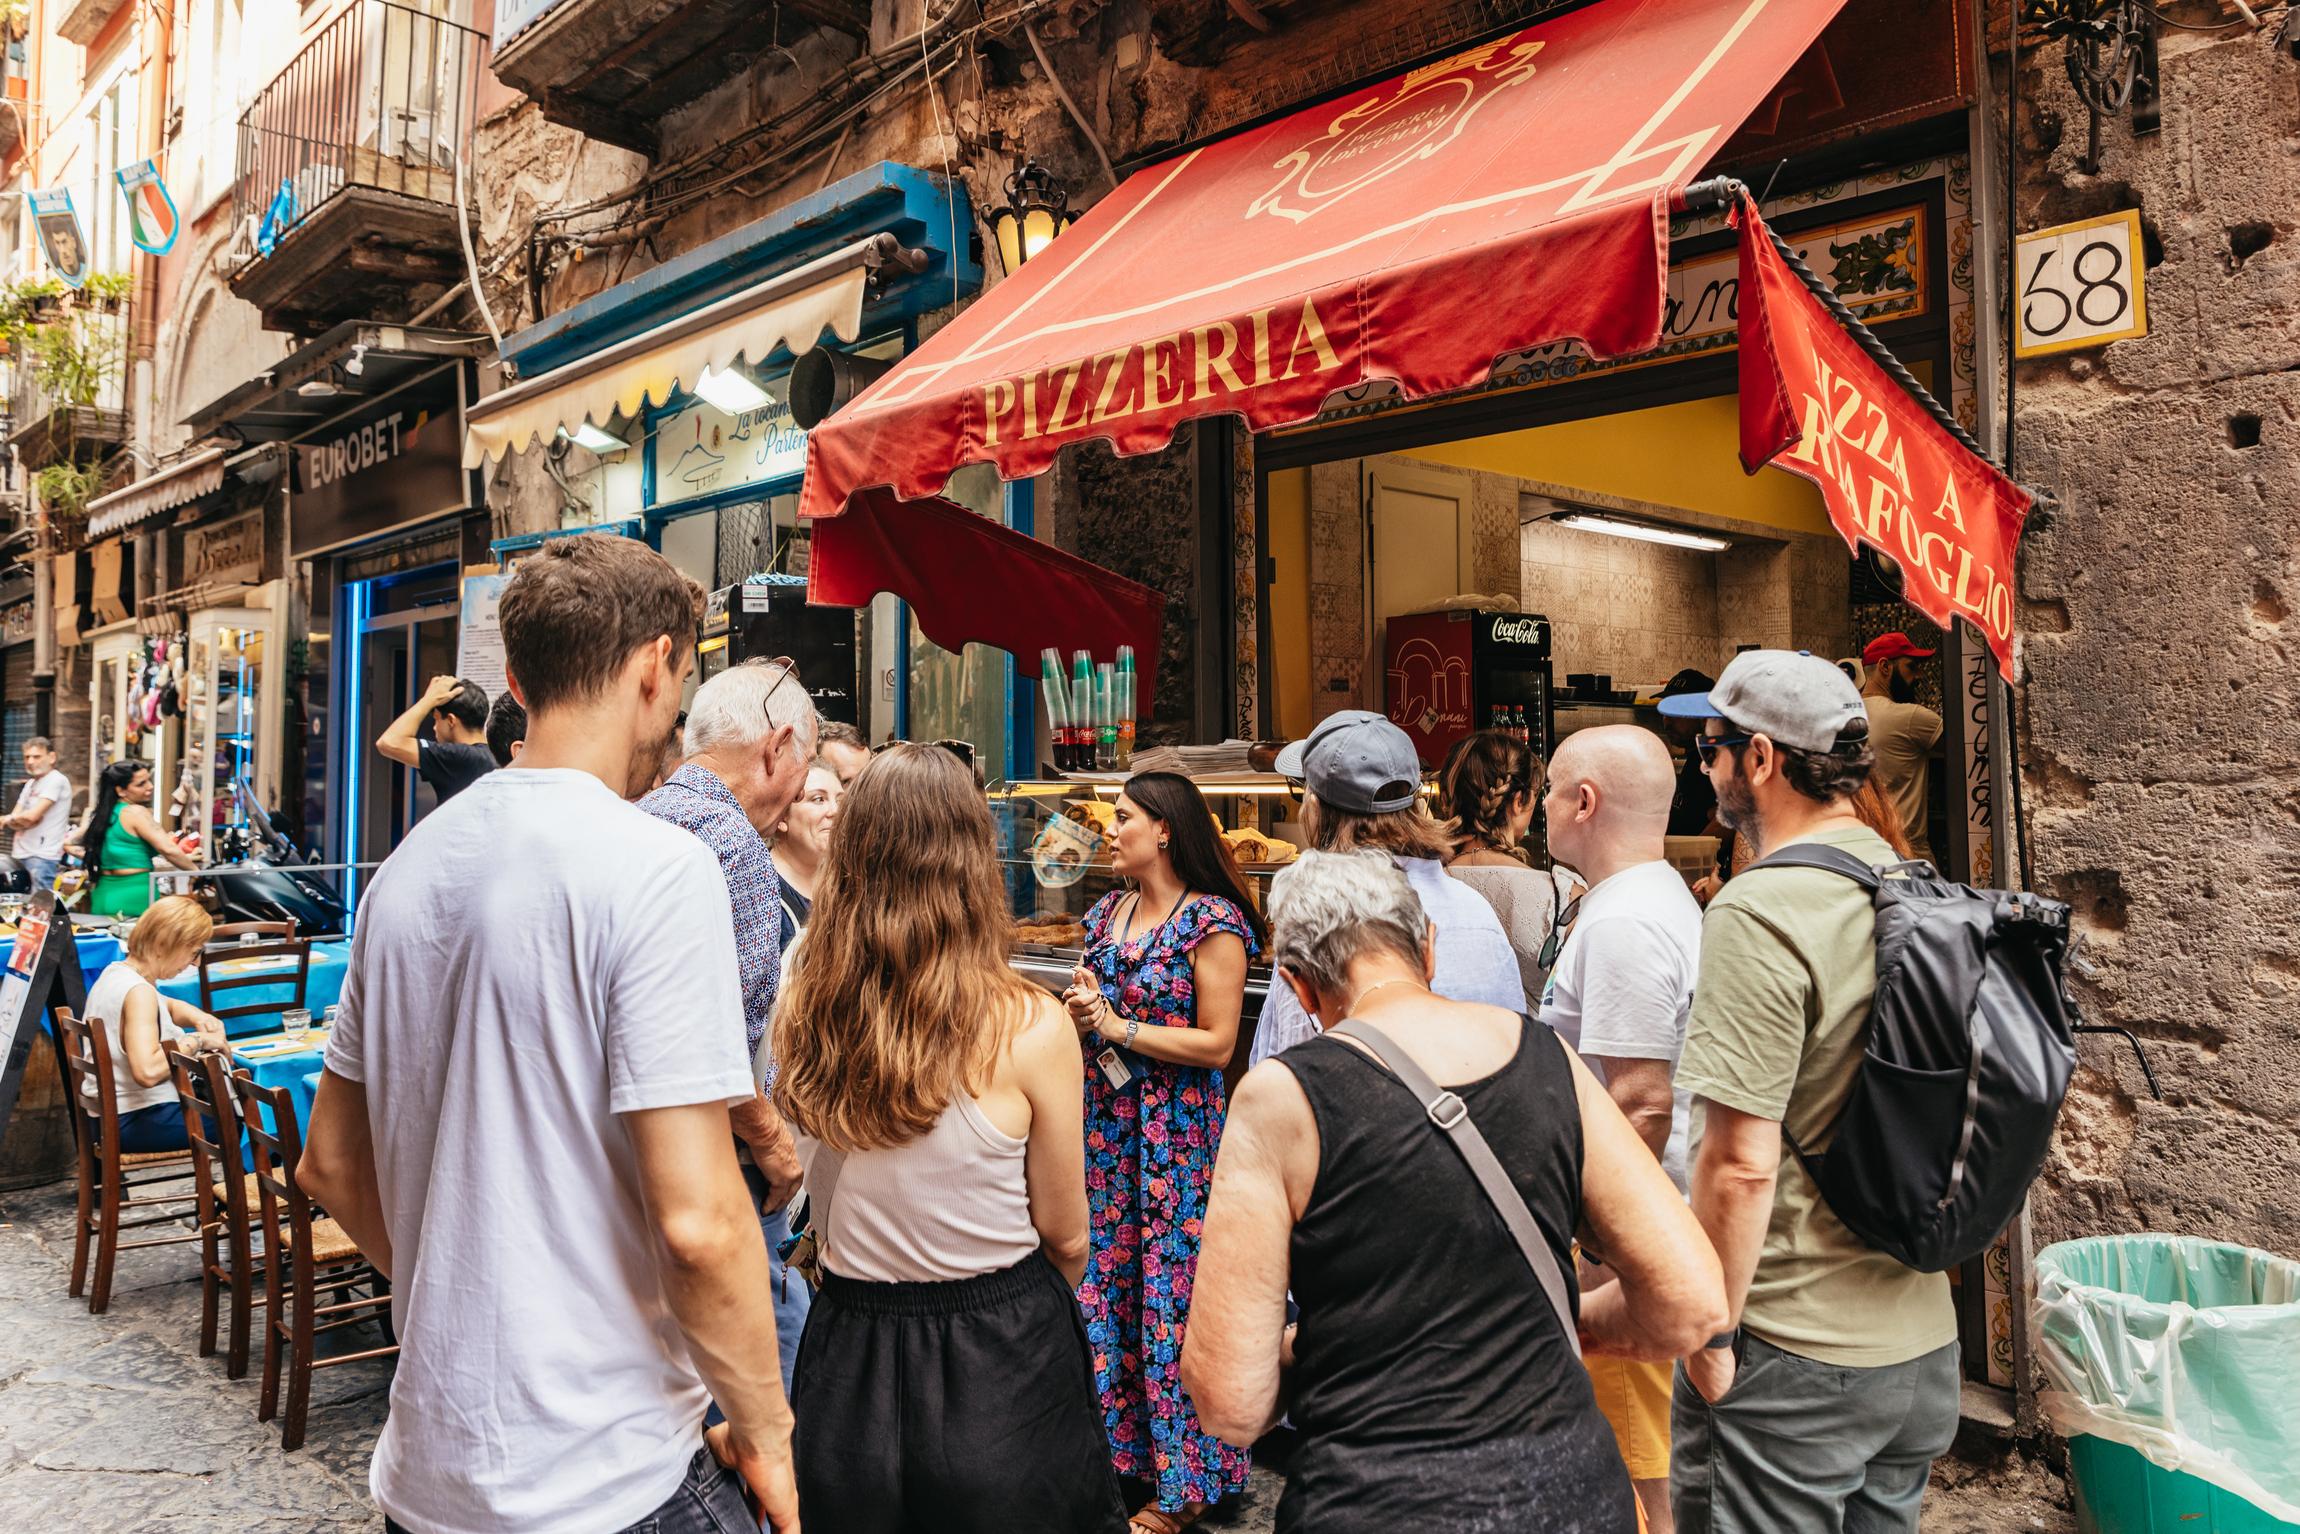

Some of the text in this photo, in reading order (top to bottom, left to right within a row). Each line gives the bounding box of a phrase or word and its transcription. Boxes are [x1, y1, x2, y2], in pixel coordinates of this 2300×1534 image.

[1331, 114, 1447, 163] DECUMANI
[1348, 103, 1447, 146] PIZZERIA
[2022, 241, 2128, 337] 68
[981, 295, 1343, 449] PIZZERIA
[310, 411, 403, 489] EUROBET
[756, 420, 808, 465] Parten
[1932, 471, 1966, 535] A
[1492, 616, 1543, 645] Coca-Cola
